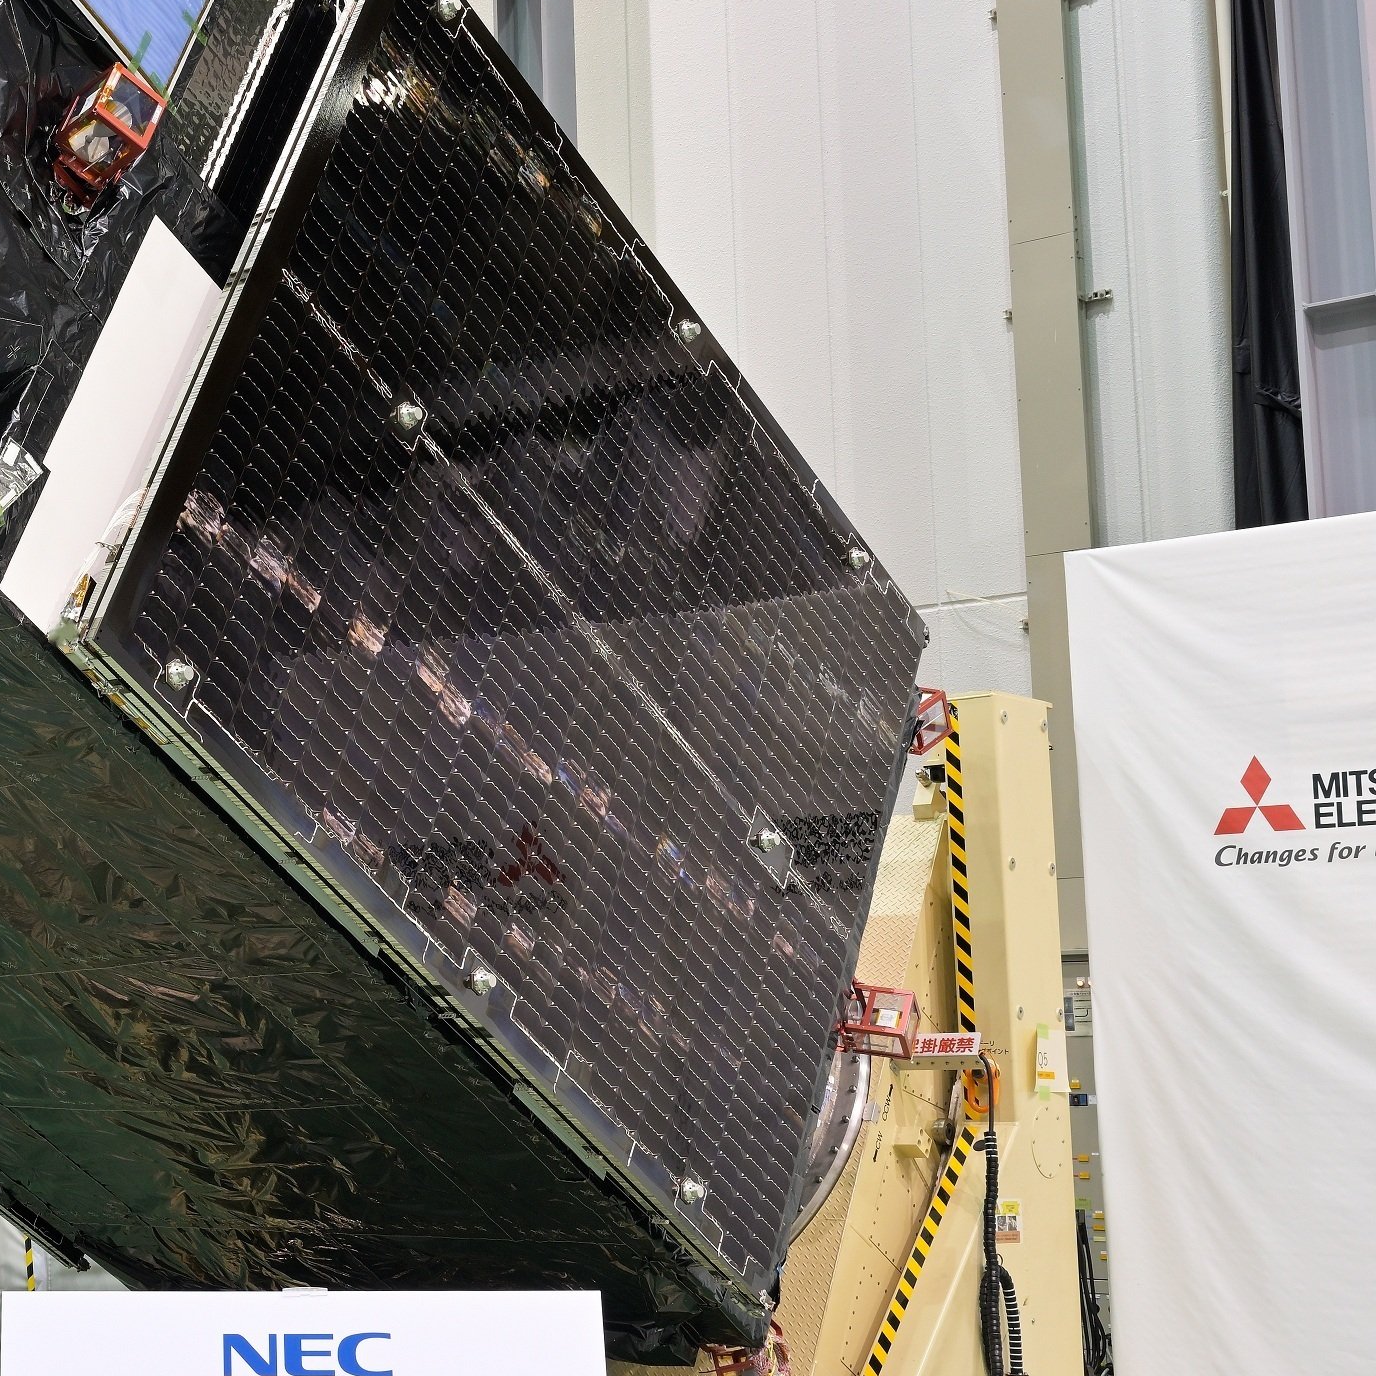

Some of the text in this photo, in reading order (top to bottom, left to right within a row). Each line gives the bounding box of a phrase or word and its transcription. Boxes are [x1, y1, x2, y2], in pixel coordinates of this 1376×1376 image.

[1214, 841, 1367, 867] Changes for
[1037, 1051, 1048, 1068] Q5
[882, 1095, 891, 1121] CCW
[875, 1131, 883, 1150] CW
